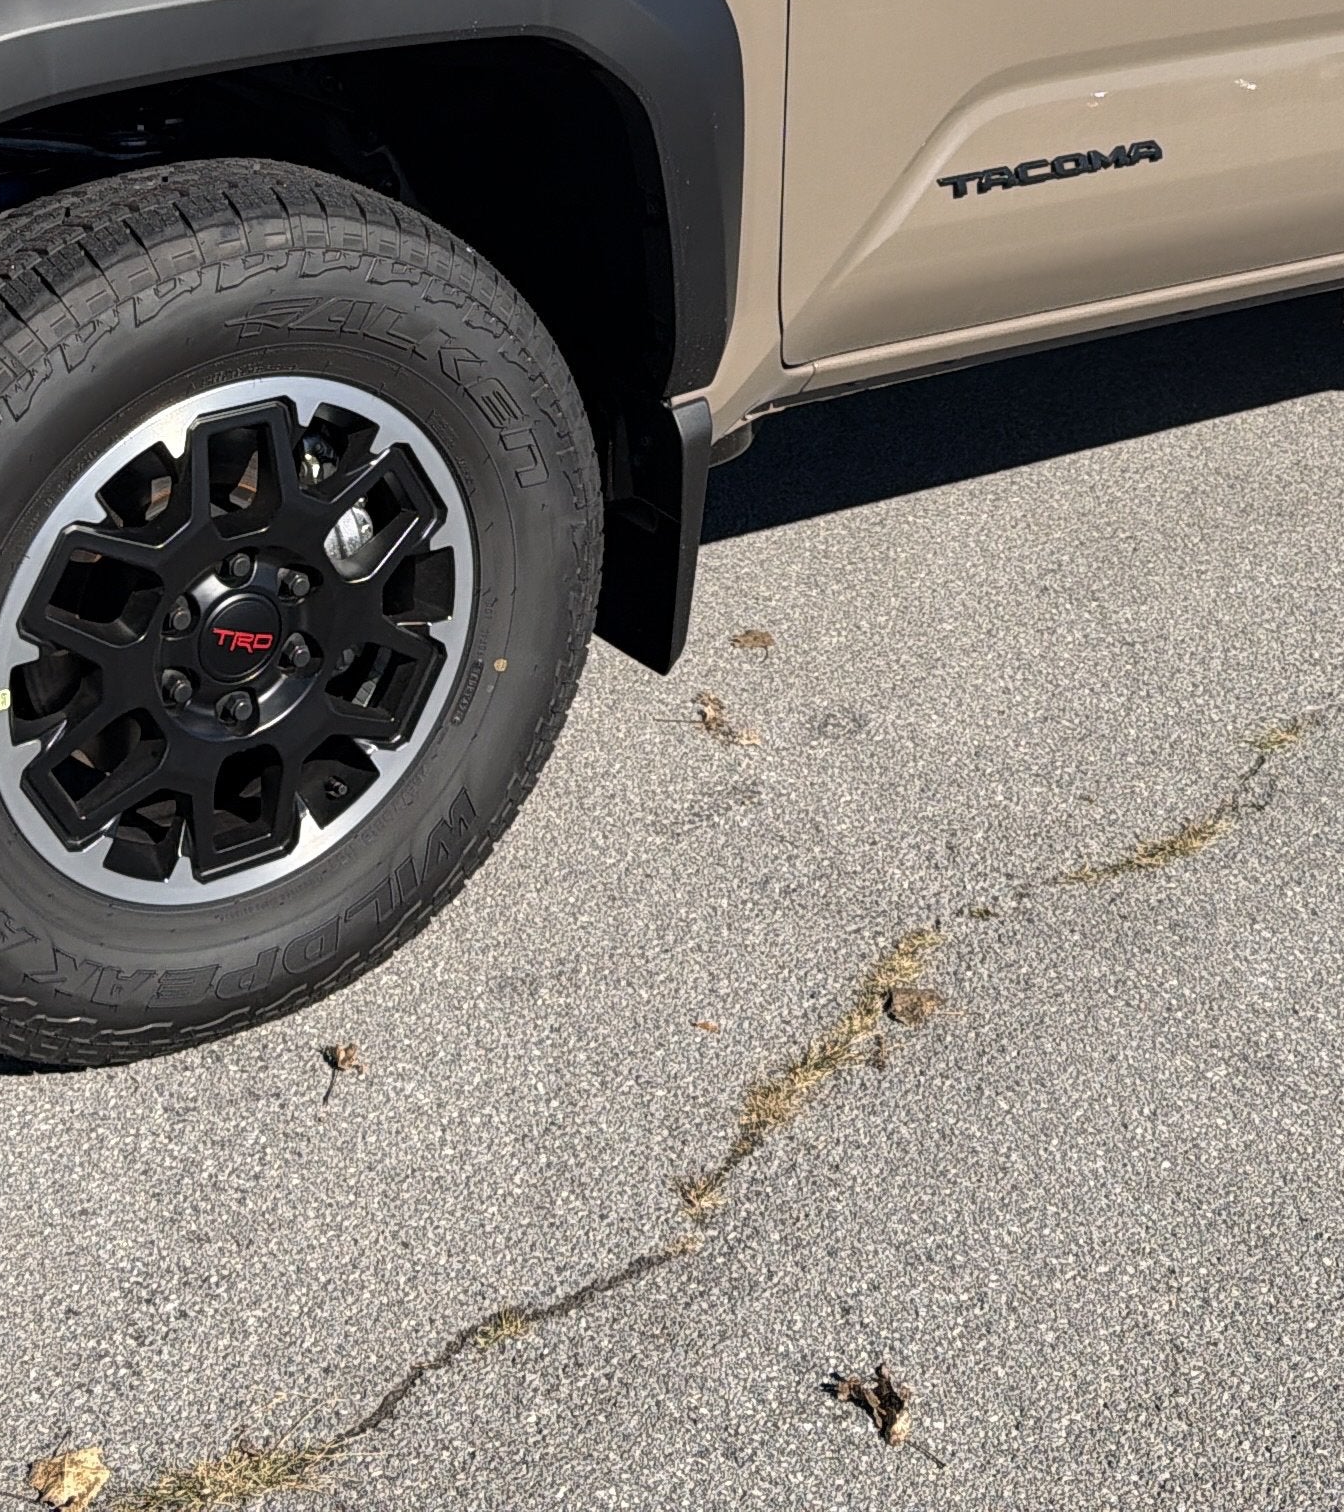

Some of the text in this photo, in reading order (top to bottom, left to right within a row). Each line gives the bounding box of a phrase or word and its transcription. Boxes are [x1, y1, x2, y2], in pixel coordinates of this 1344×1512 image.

[936, 140, 1163, 199] TACOMA
[224, 297, 550, 489] FALKEN
[212, 628, 273, 654] TRD
[23, 787, 478, 1012] WILDPEAK
